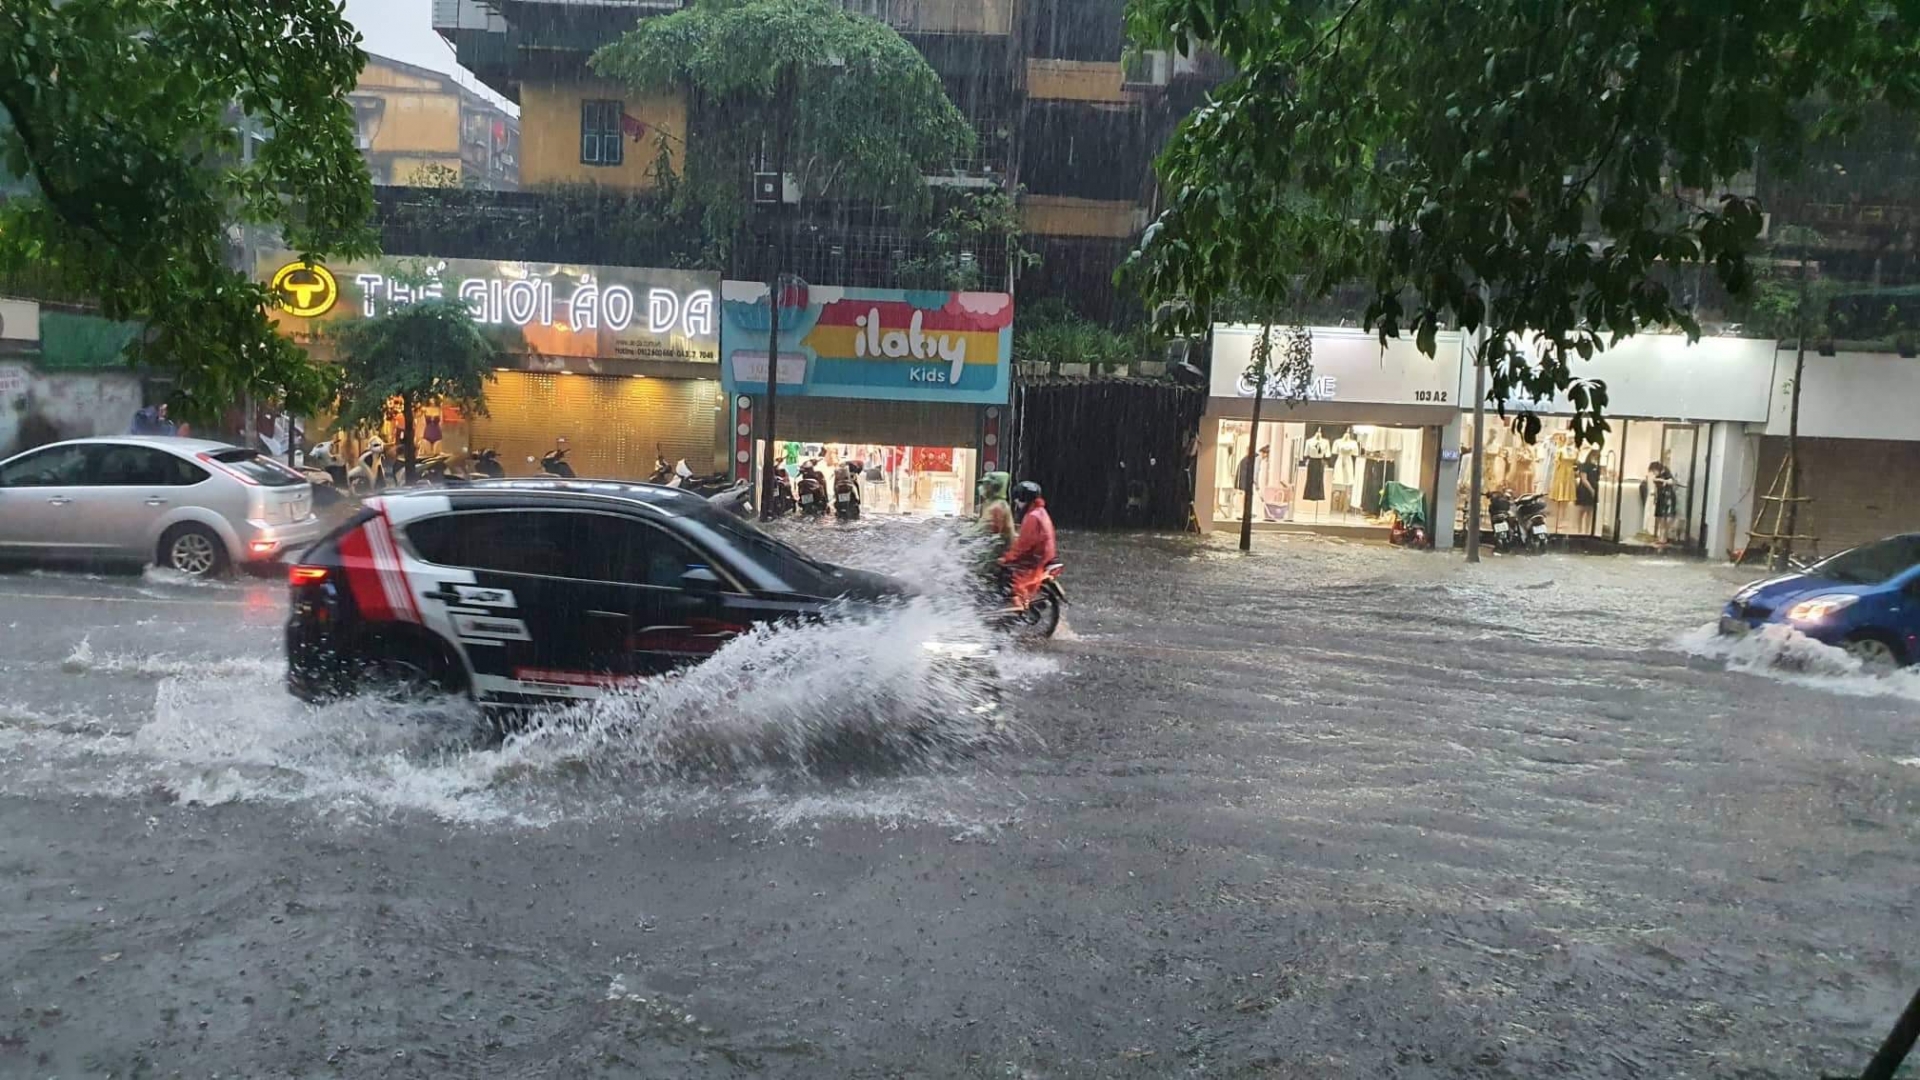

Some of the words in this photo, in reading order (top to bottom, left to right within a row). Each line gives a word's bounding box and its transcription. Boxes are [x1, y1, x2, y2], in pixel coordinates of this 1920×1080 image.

[459, 269, 553, 325] GIỚI
[570, 274, 634, 333] ÁO
[649, 287, 713, 338] DA
[855, 307, 966, 385] ilaby
[909, 367, 946, 382] Kids
[1236, 375, 1337, 398] CAME
[1415, 390, 1432, 402] 103
[1433, 390, 1448, 402] A2
